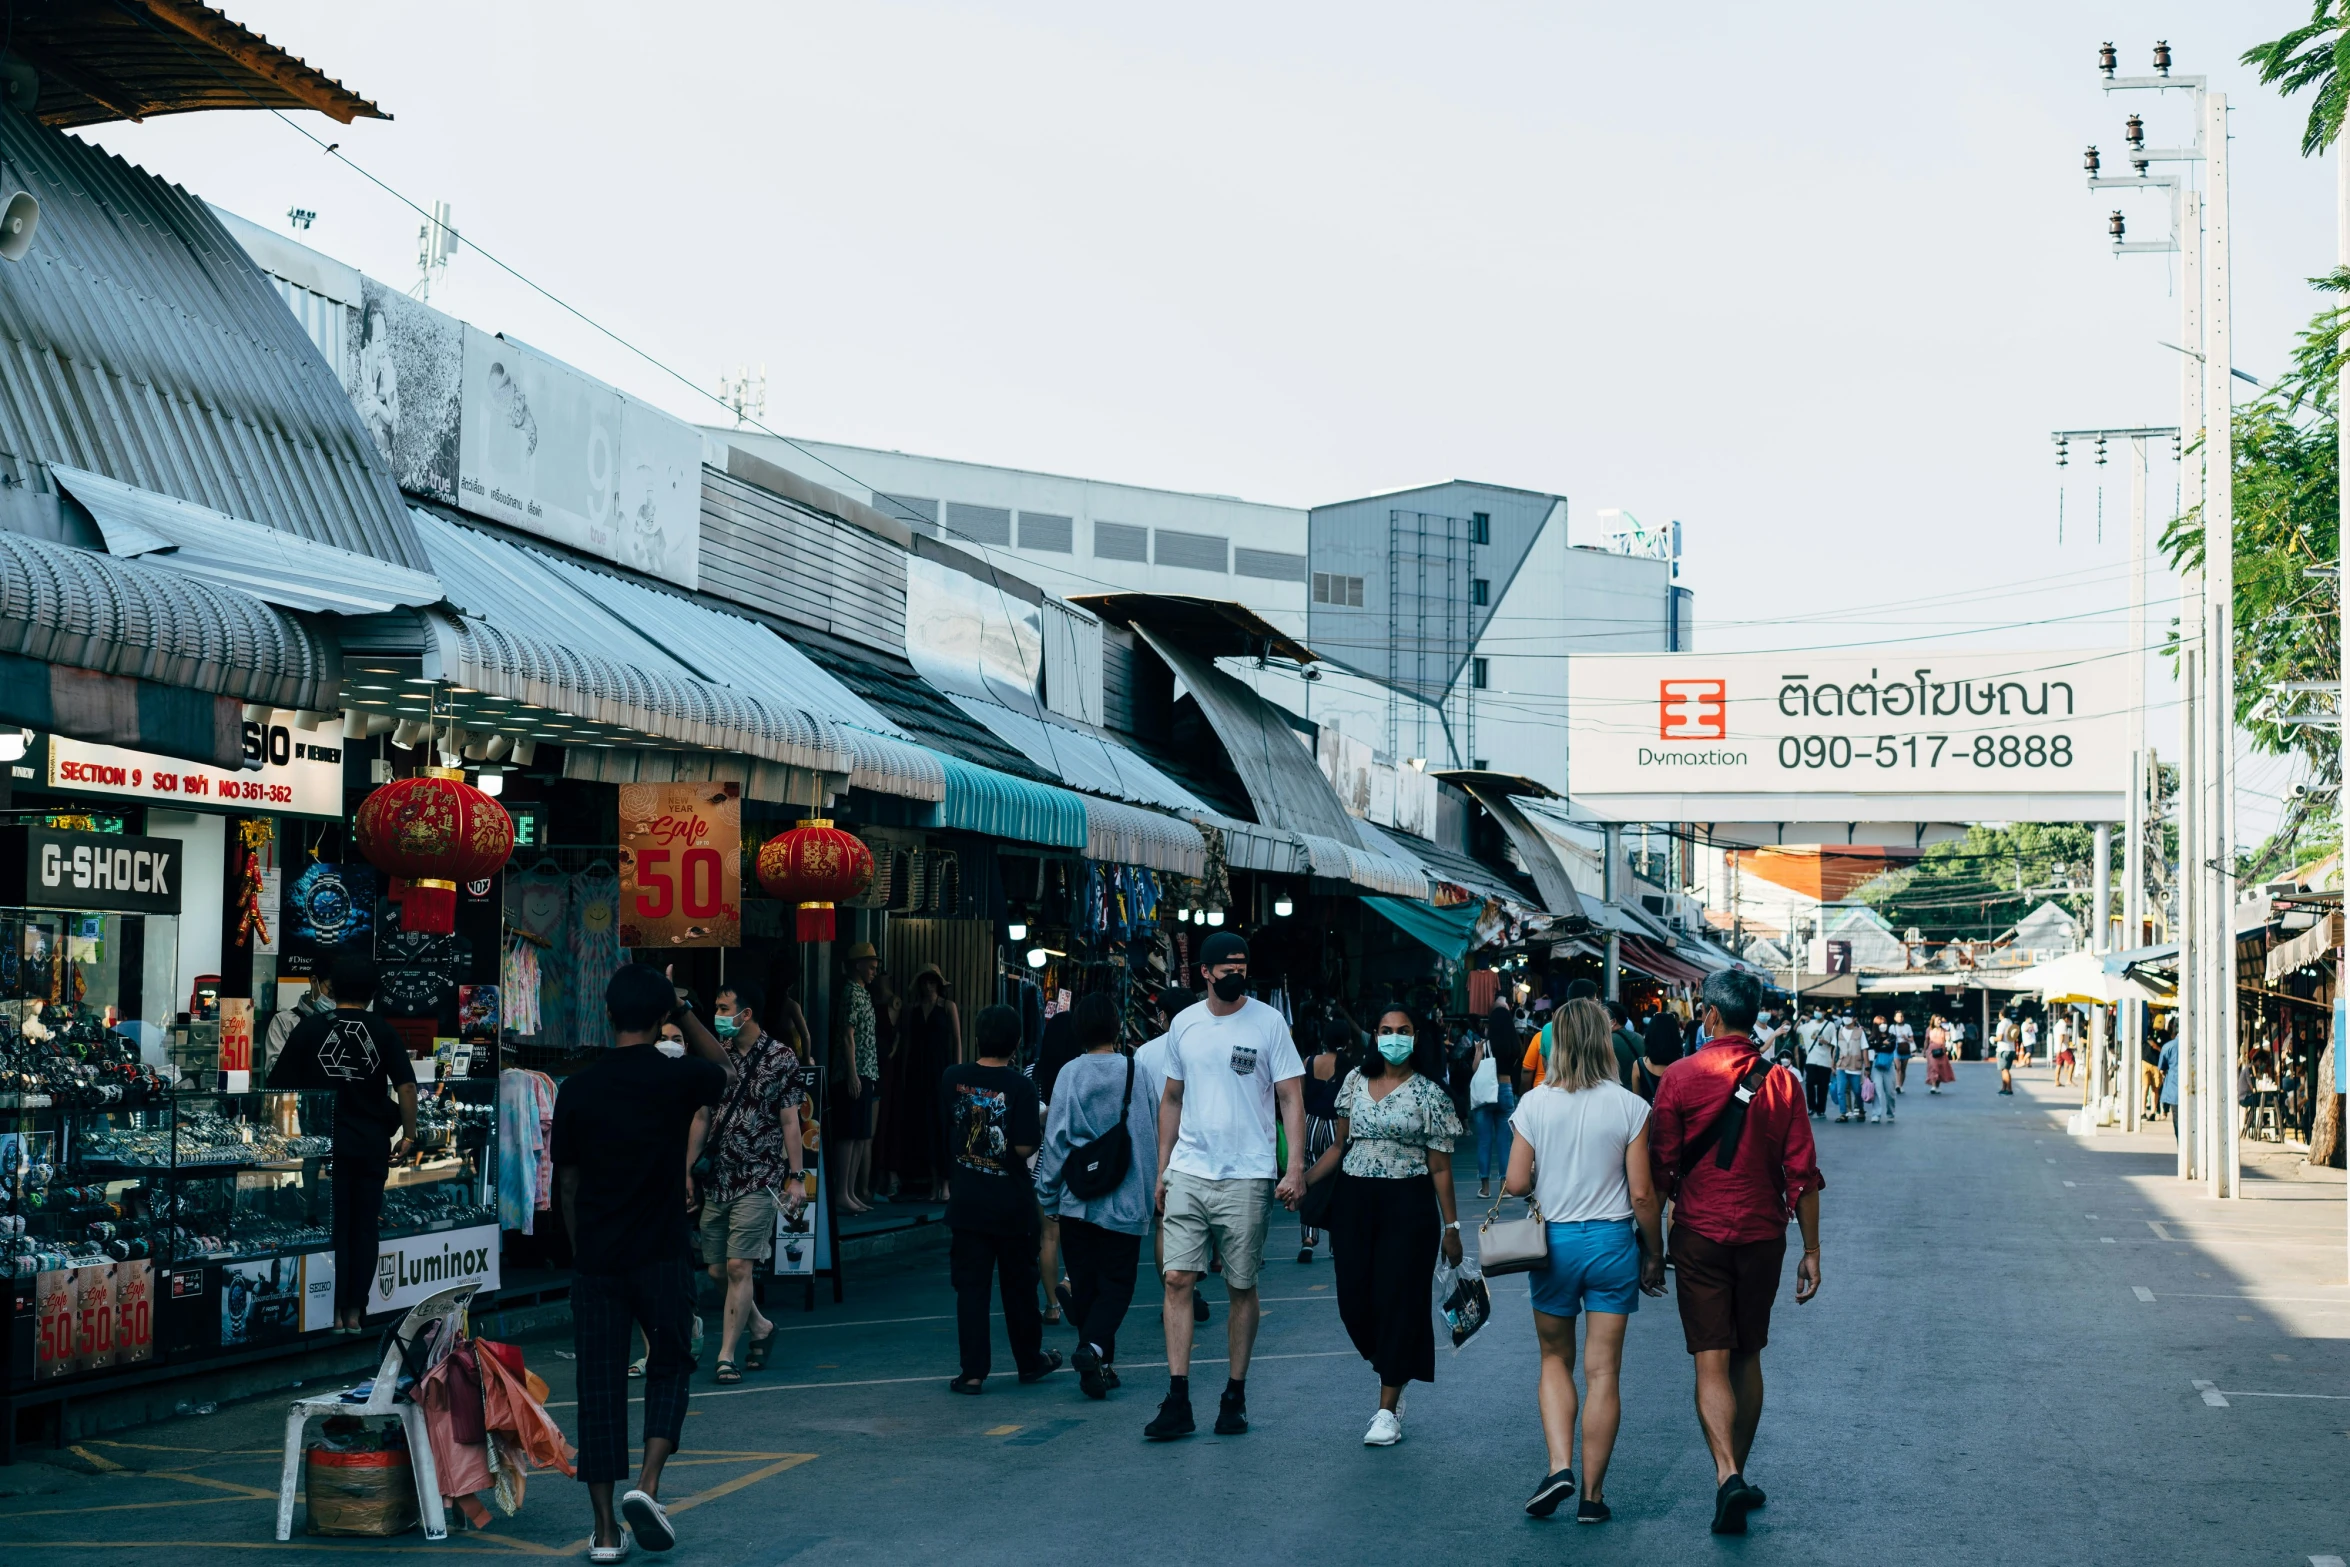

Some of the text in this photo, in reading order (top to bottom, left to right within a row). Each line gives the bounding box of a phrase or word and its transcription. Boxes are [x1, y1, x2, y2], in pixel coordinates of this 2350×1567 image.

[429, 469, 451, 493] true
[590, 525, 607, 545] true
[1777, 668, 2074, 717] ติดต่อโฆษณา
[1638, 747, 1747, 768] Dymaxtion
[1778, 735, 2073, 769] 090-517-8888
[61, 761, 126, 786] SECTION
[133, 769, 142, 787] 9
[153, 772, 178, 792] SOI
[183, 774, 208, 795] 19/1
[219, 781, 240, 798] NO
[242, 782, 292, 802] 361-362
[669, 805, 693, 813] YEAR
[651, 815, 710, 847] Sale
[42, 844, 169, 894] G-SHOCK
[1833, 954, 1844, 971] 7
[230, 1017, 246, 1033] Sale
[224, 1035, 248, 1070] 50
[379, 1255, 395, 1275] LUM
[399, 1243, 489, 1287] Luminox
[88, 1285, 107, 1306] Sale
[127, 1280, 145, 1300] Sale
[309, 1281, 331, 1294] SEIKO
[380, 1276, 394, 1297] NOX
[47, 1291, 67, 1313] Sale
[418, 1303, 437, 1316] LEK
